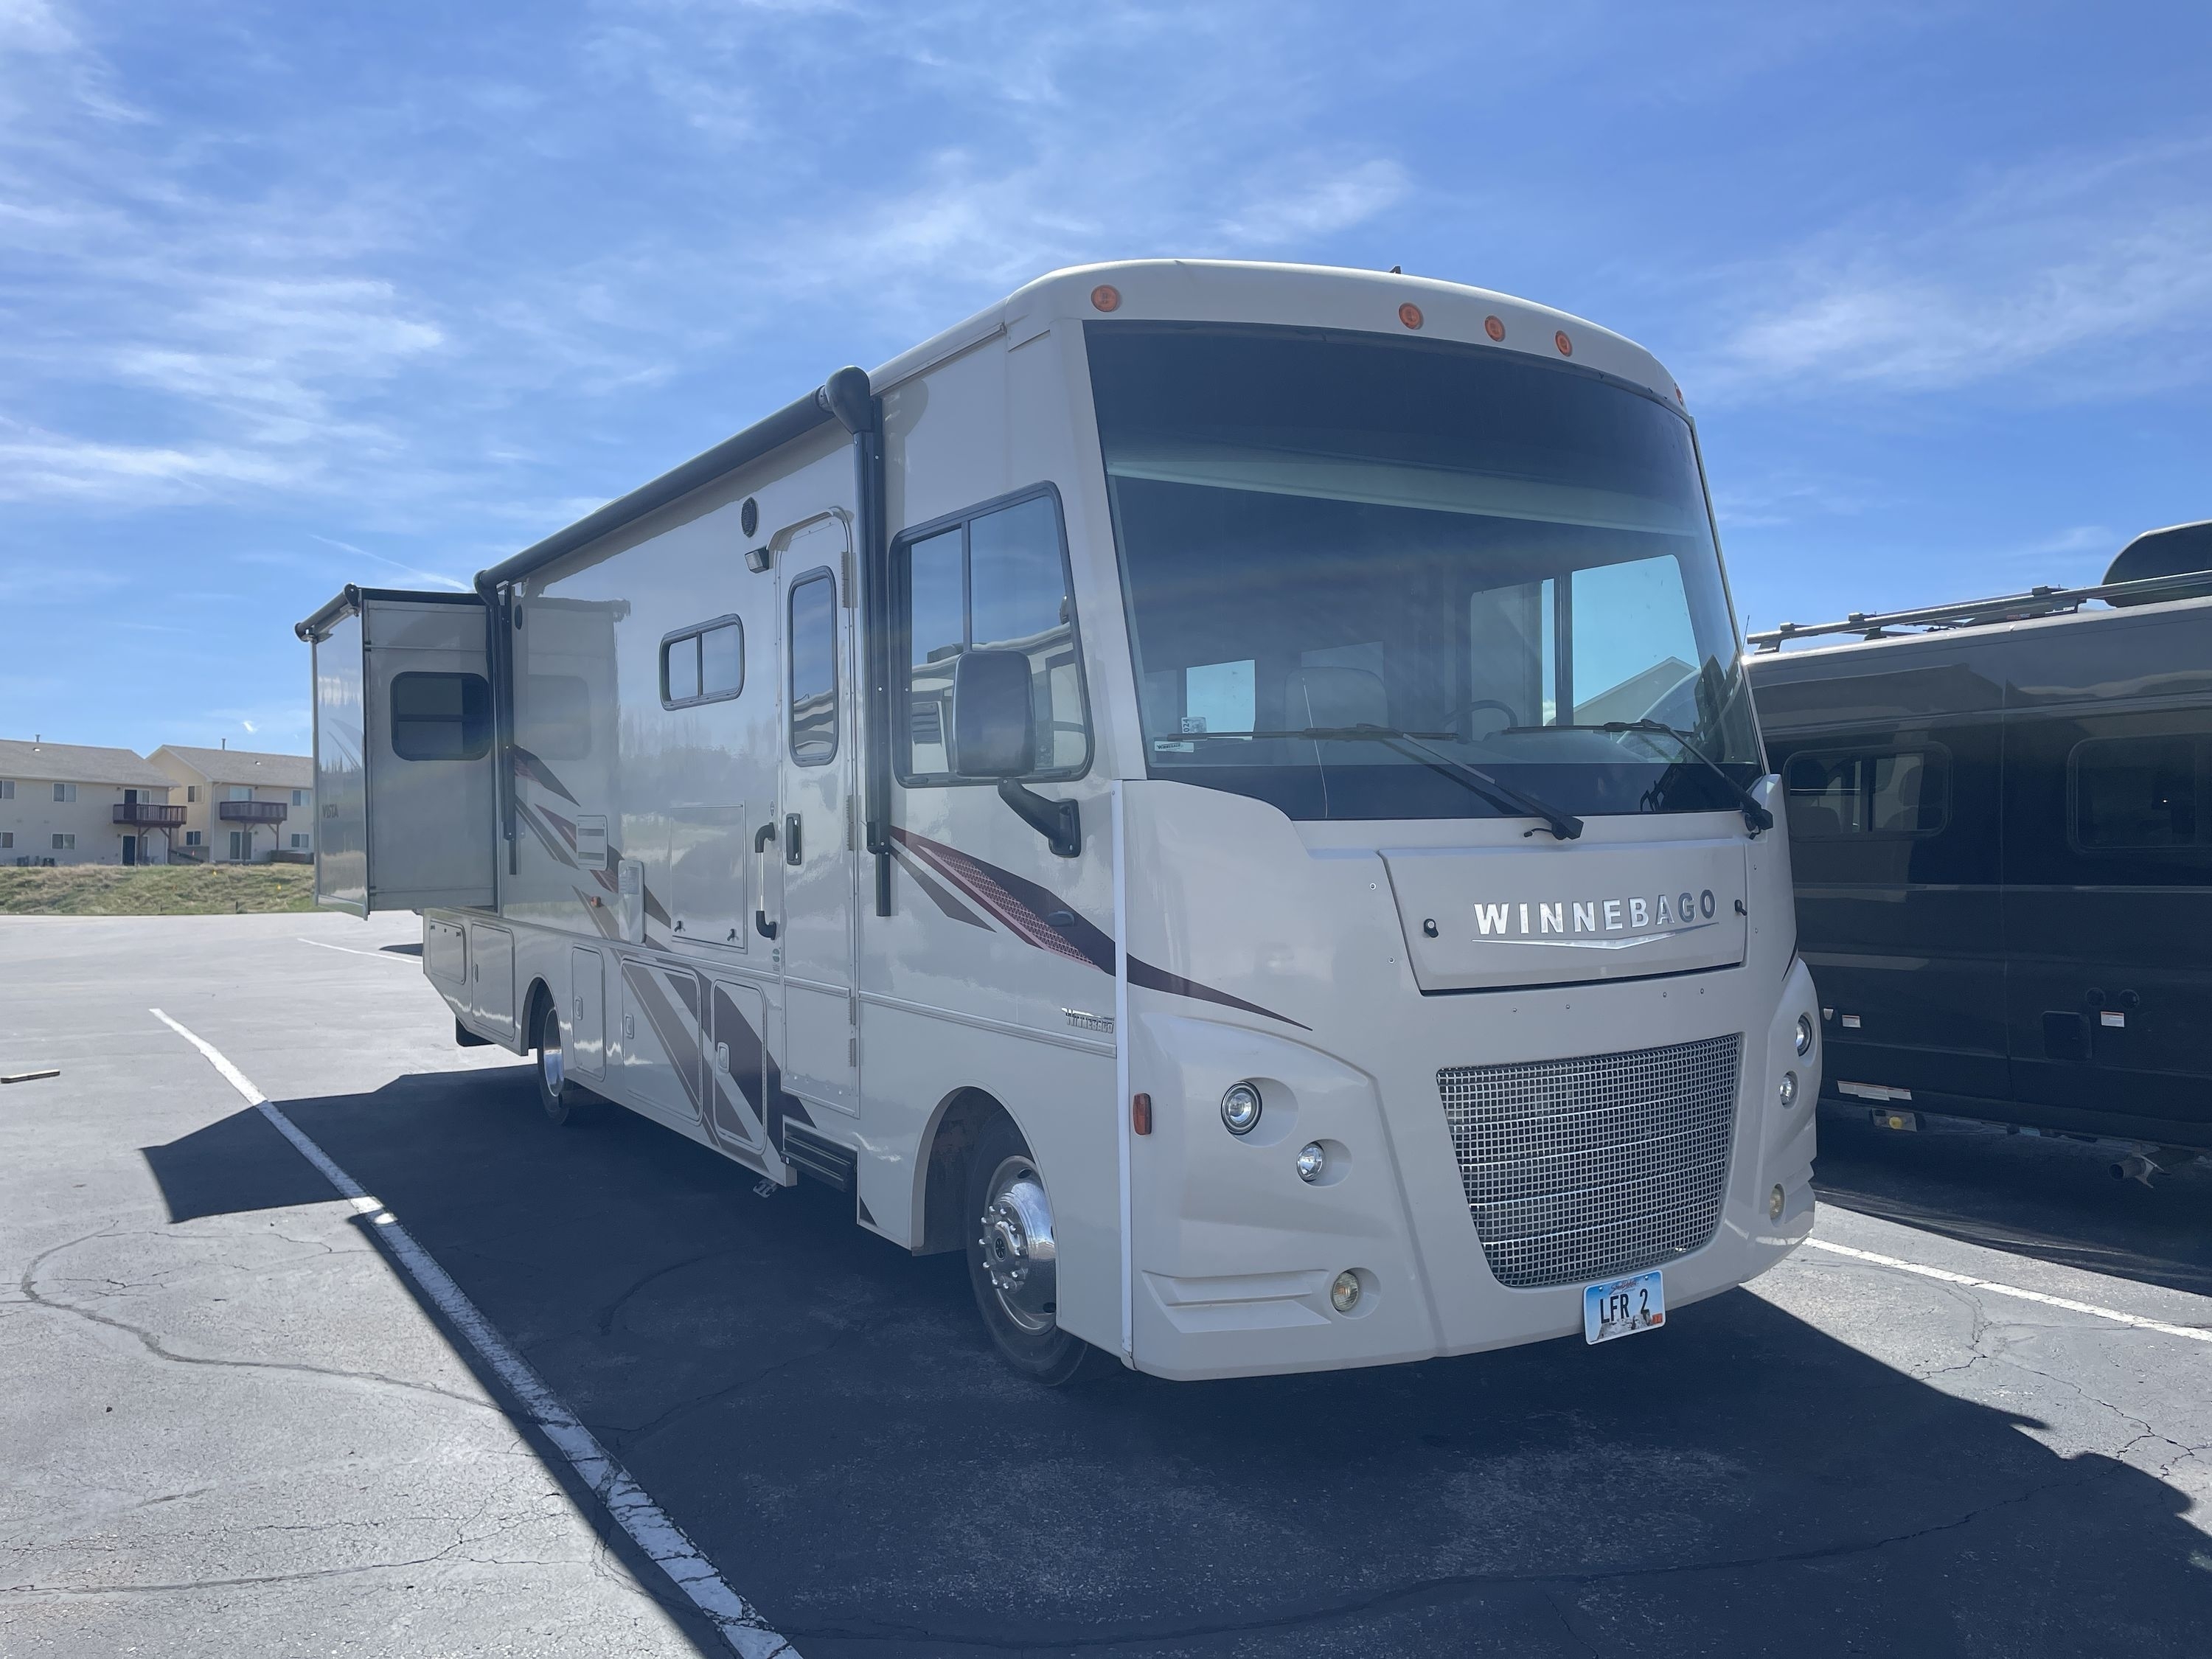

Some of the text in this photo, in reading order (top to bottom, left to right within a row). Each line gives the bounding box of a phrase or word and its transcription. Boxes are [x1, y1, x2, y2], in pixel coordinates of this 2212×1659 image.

[1474, 889, 1717, 936] WINNEBAGO
[1599, 1288, 1650, 1324] LFR 2
